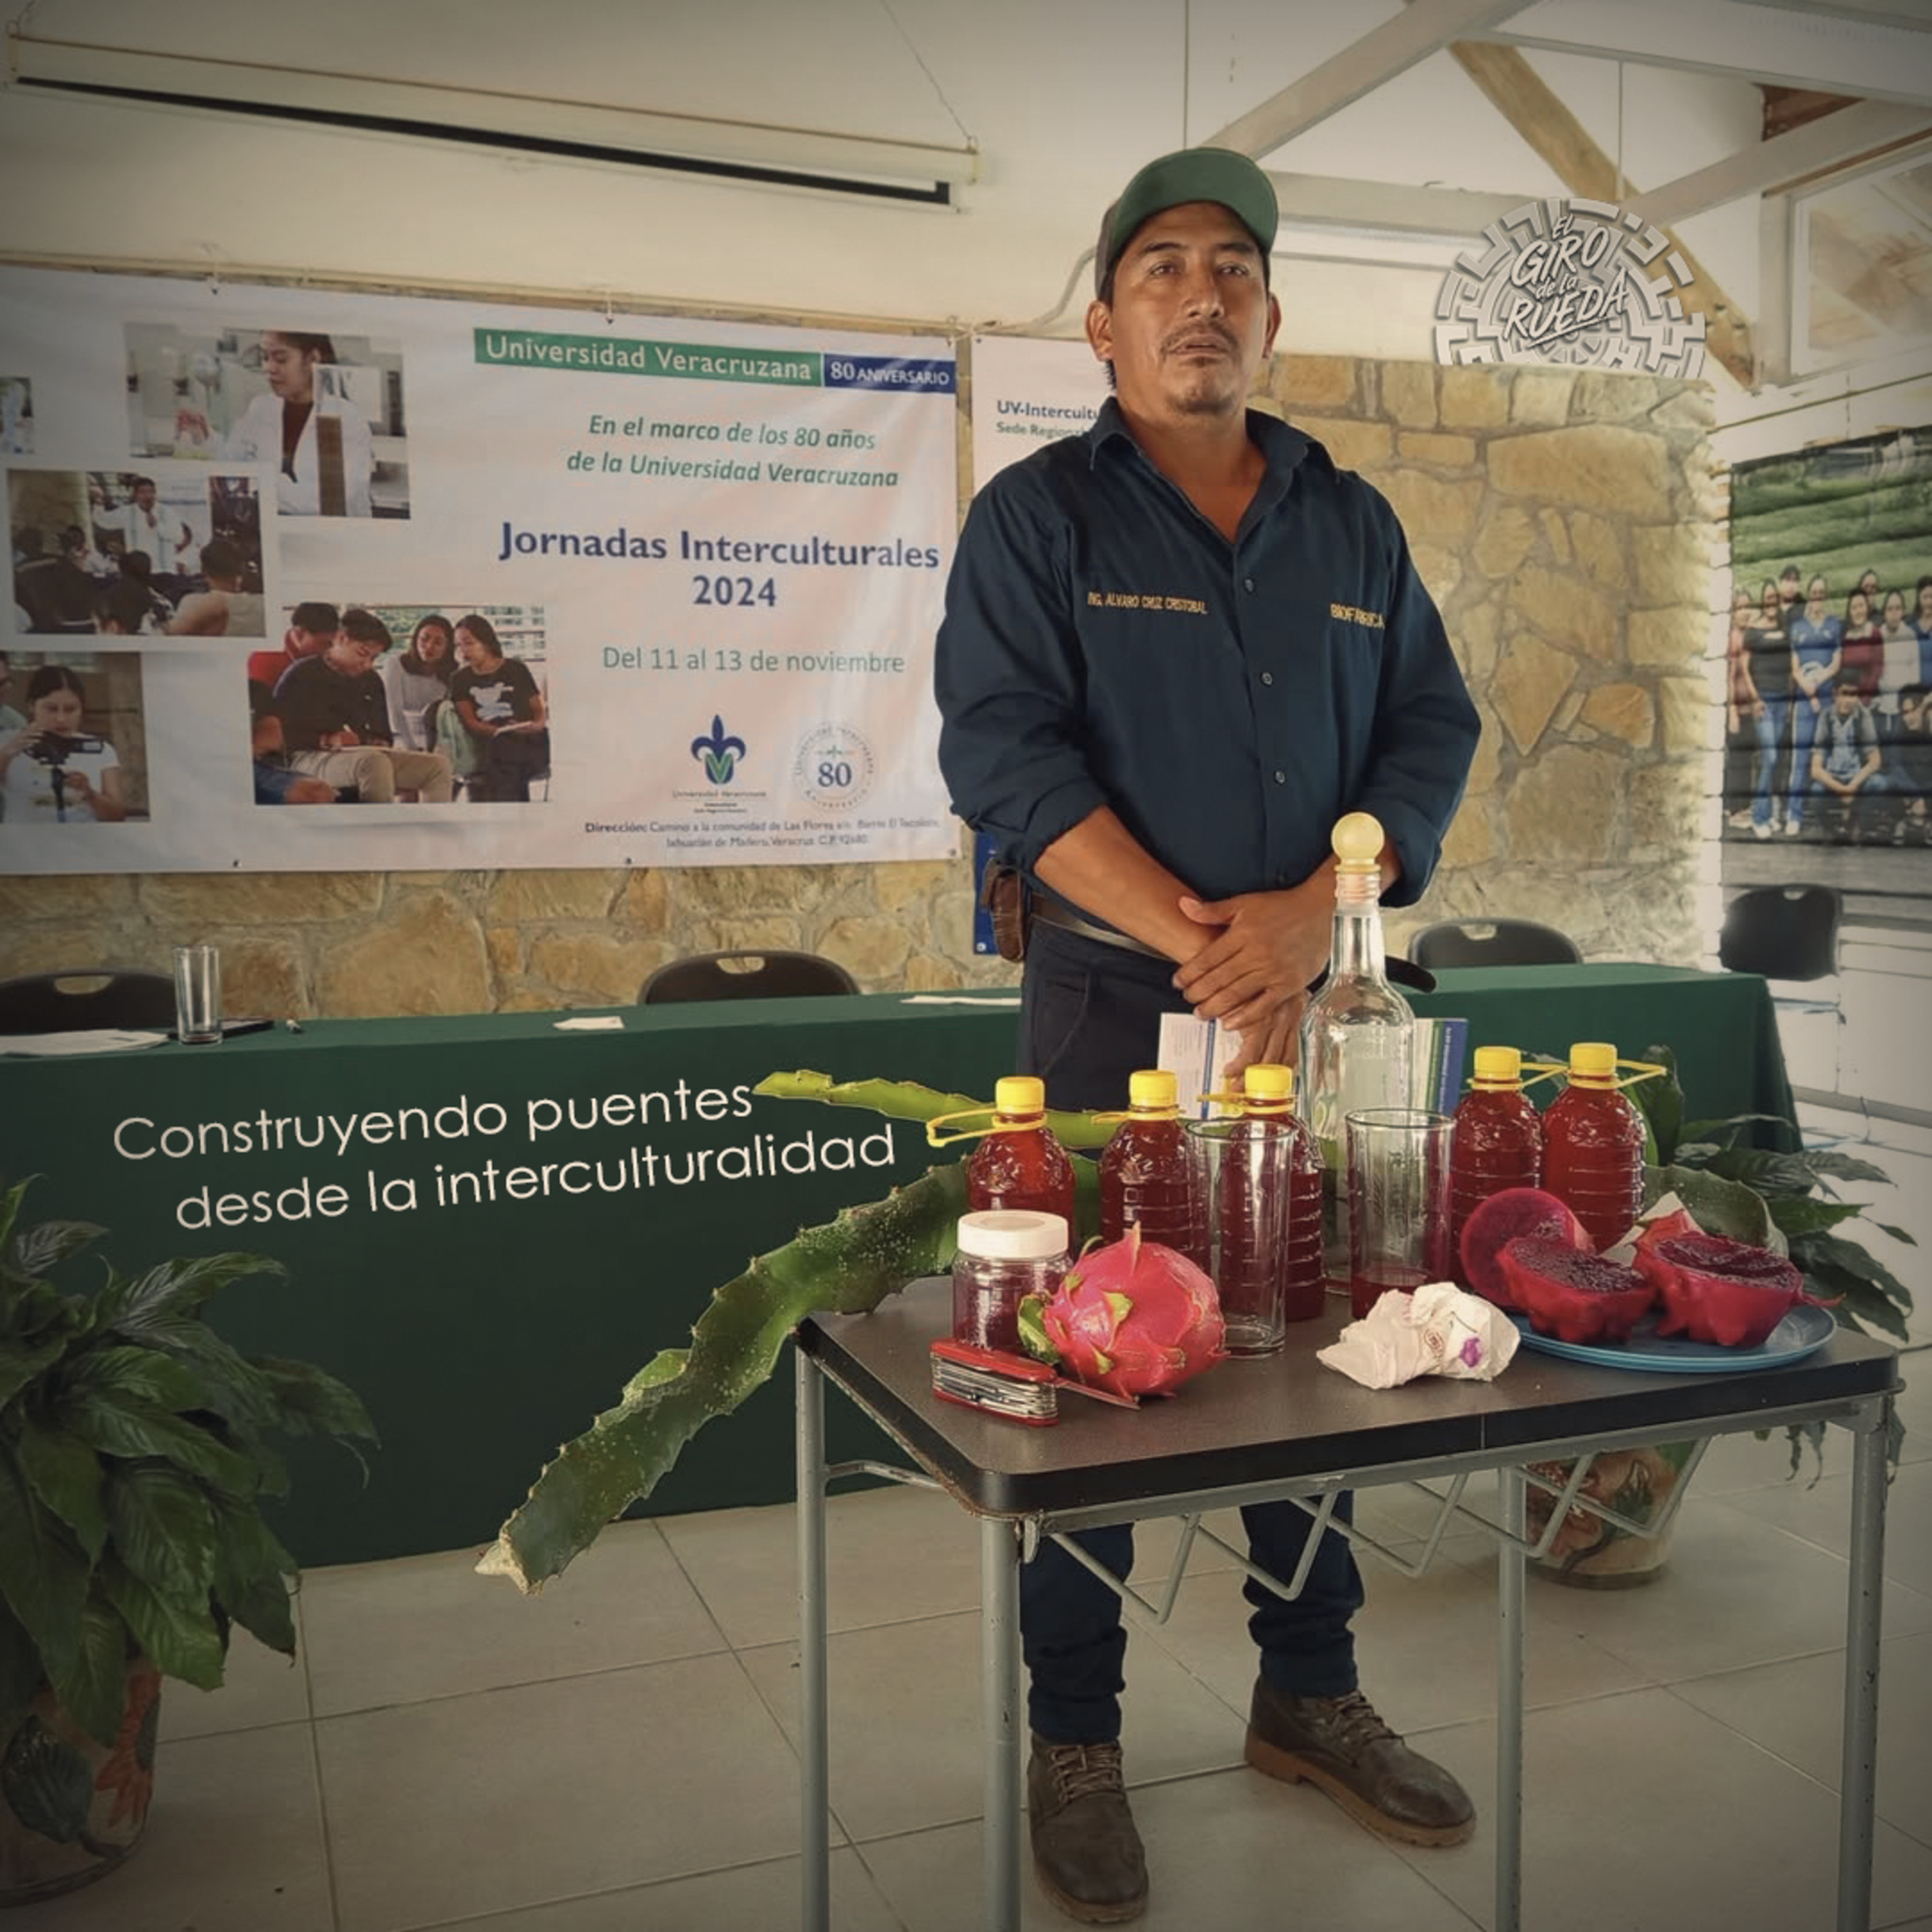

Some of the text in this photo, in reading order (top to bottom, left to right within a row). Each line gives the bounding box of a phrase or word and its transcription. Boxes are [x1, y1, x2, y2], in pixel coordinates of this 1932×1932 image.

[486, 334, 811, 380] Universidad Veracruzana
[830, 361, 949, 386] 80 ANIVERSARIO
[589, 414, 876, 450] En el marco de los 80 años
[567, 451, 898, 488] de la Universidad Veracruzana
[498, 522, 940, 568] Jornadas Interculturales
[692, 574, 777, 607] 2024
[603, 647, 905, 673] Del 11 al 13 de noviembre
[818, 761, 852, 788] 80
[585, 822, 647, 833] Dirección:
